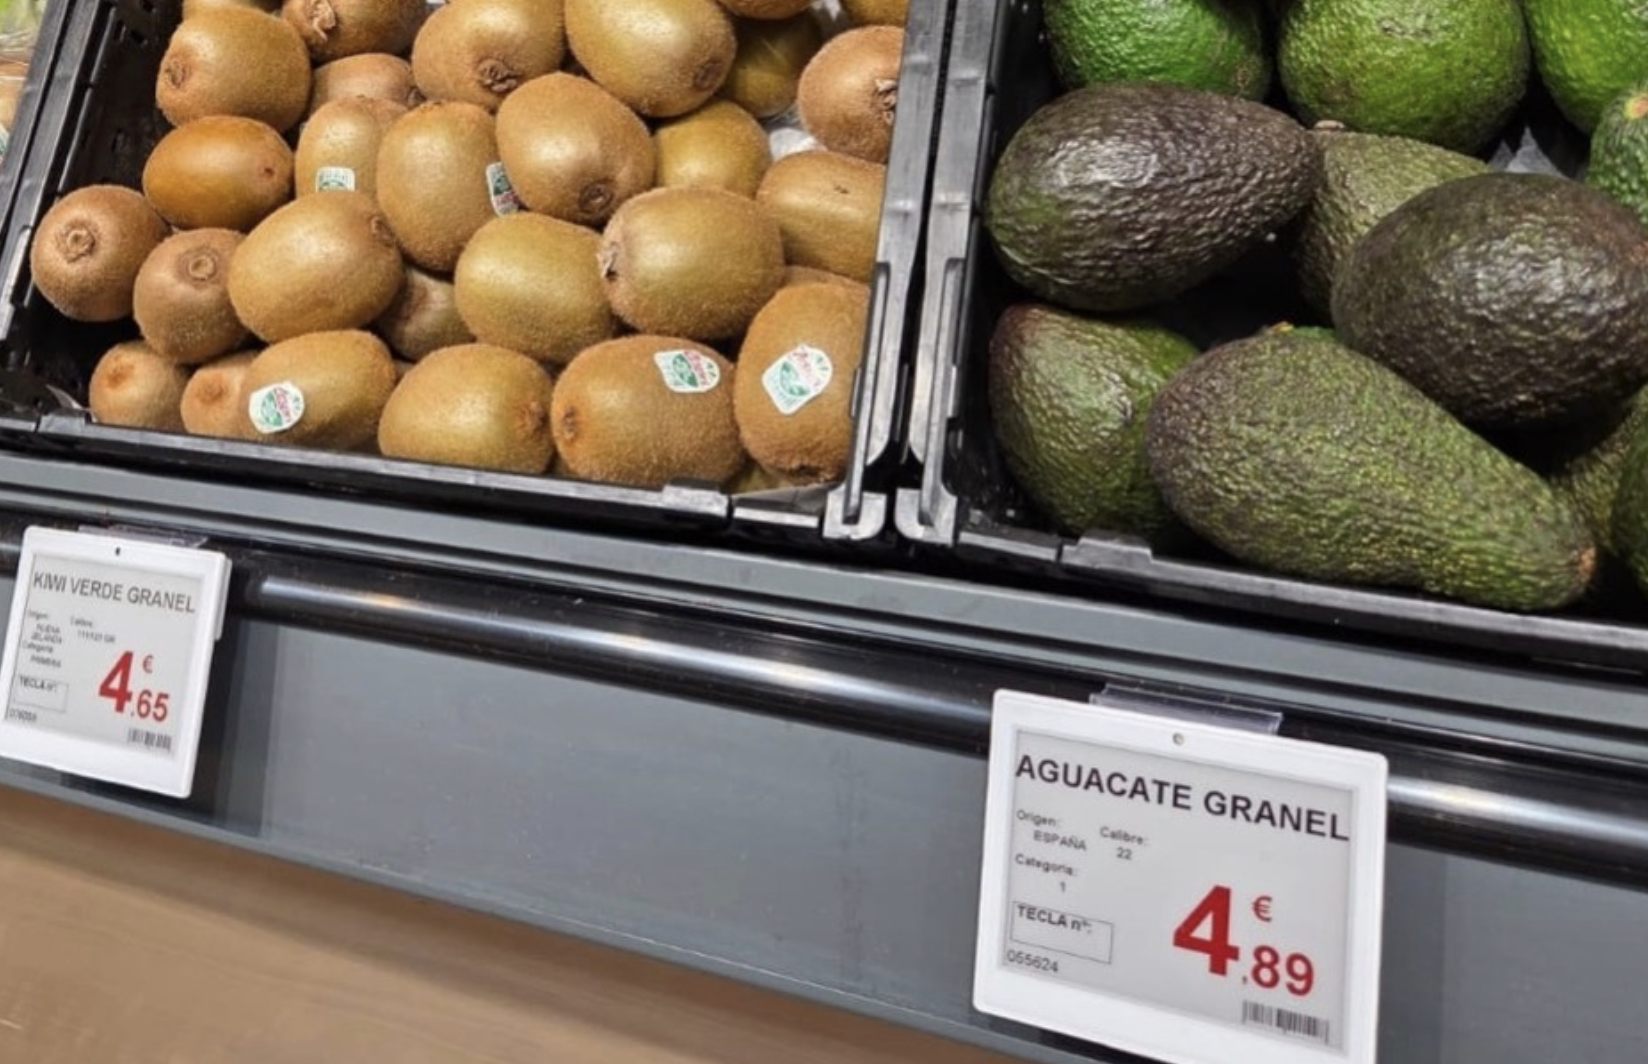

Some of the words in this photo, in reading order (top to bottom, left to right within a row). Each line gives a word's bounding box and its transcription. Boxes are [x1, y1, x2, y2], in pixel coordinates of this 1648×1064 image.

[33, 572, 66, 593] KIWI
[71, 578, 123, 602] VERDE
[127, 587, 195, 613] GRANEL
[1015, 754, 1192, 811] AGUACATE
[1204, 790, 1350, 842] GRANEL
[1016, 810, 1060, 827] Origen:
[1033, 830, 1087, 851] ESPAÑA
[1099, 826, 1148, 846] Calibre:
[1116, 847, 1132, 860] 22
[1017, 905, 1068, 928] TECLA
[1252, 896, 1272, 922] €
